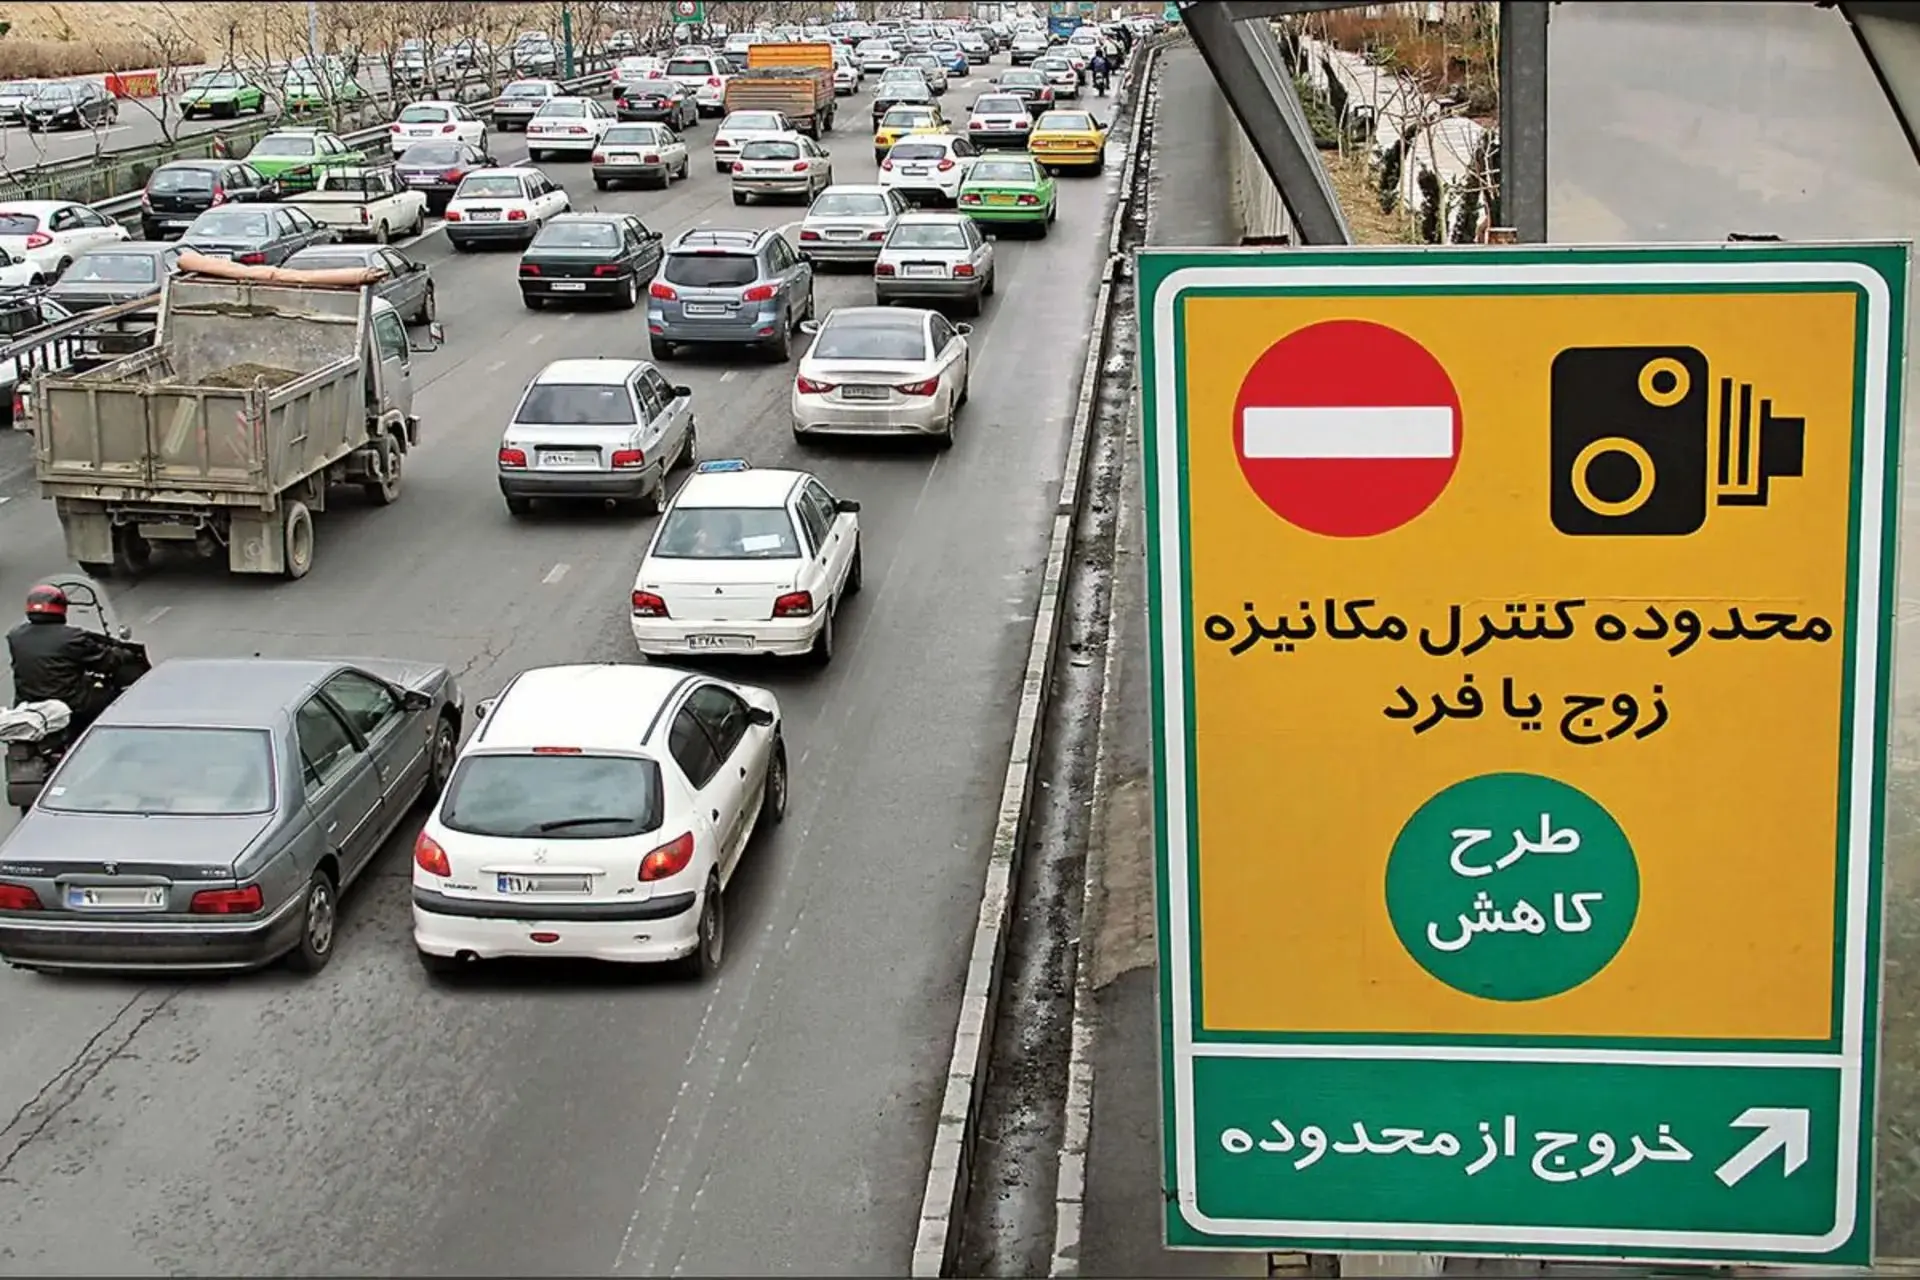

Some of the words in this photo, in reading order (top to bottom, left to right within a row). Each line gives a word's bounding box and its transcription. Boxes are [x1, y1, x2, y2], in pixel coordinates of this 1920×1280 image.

[1204, 598, 1408, 657] مکانیزه
[1419, 599, 1586, 657] کنترل
[1594, 604, 1834, 658] محدوده
[1383, 673, 1484, 736] فرد
[1502, 677, 1542, 731] یا
[1559, 684, 1669, 745] زوج
[1449, 812, 1581, 878] طرح
[1426, 890, 1604, 951] کاهش
[1220, 1118, 1461, 1171] محدوده
[1465, 1114, 1517, 1176] از
[1531, 1123, 1694, 1182] خروج
